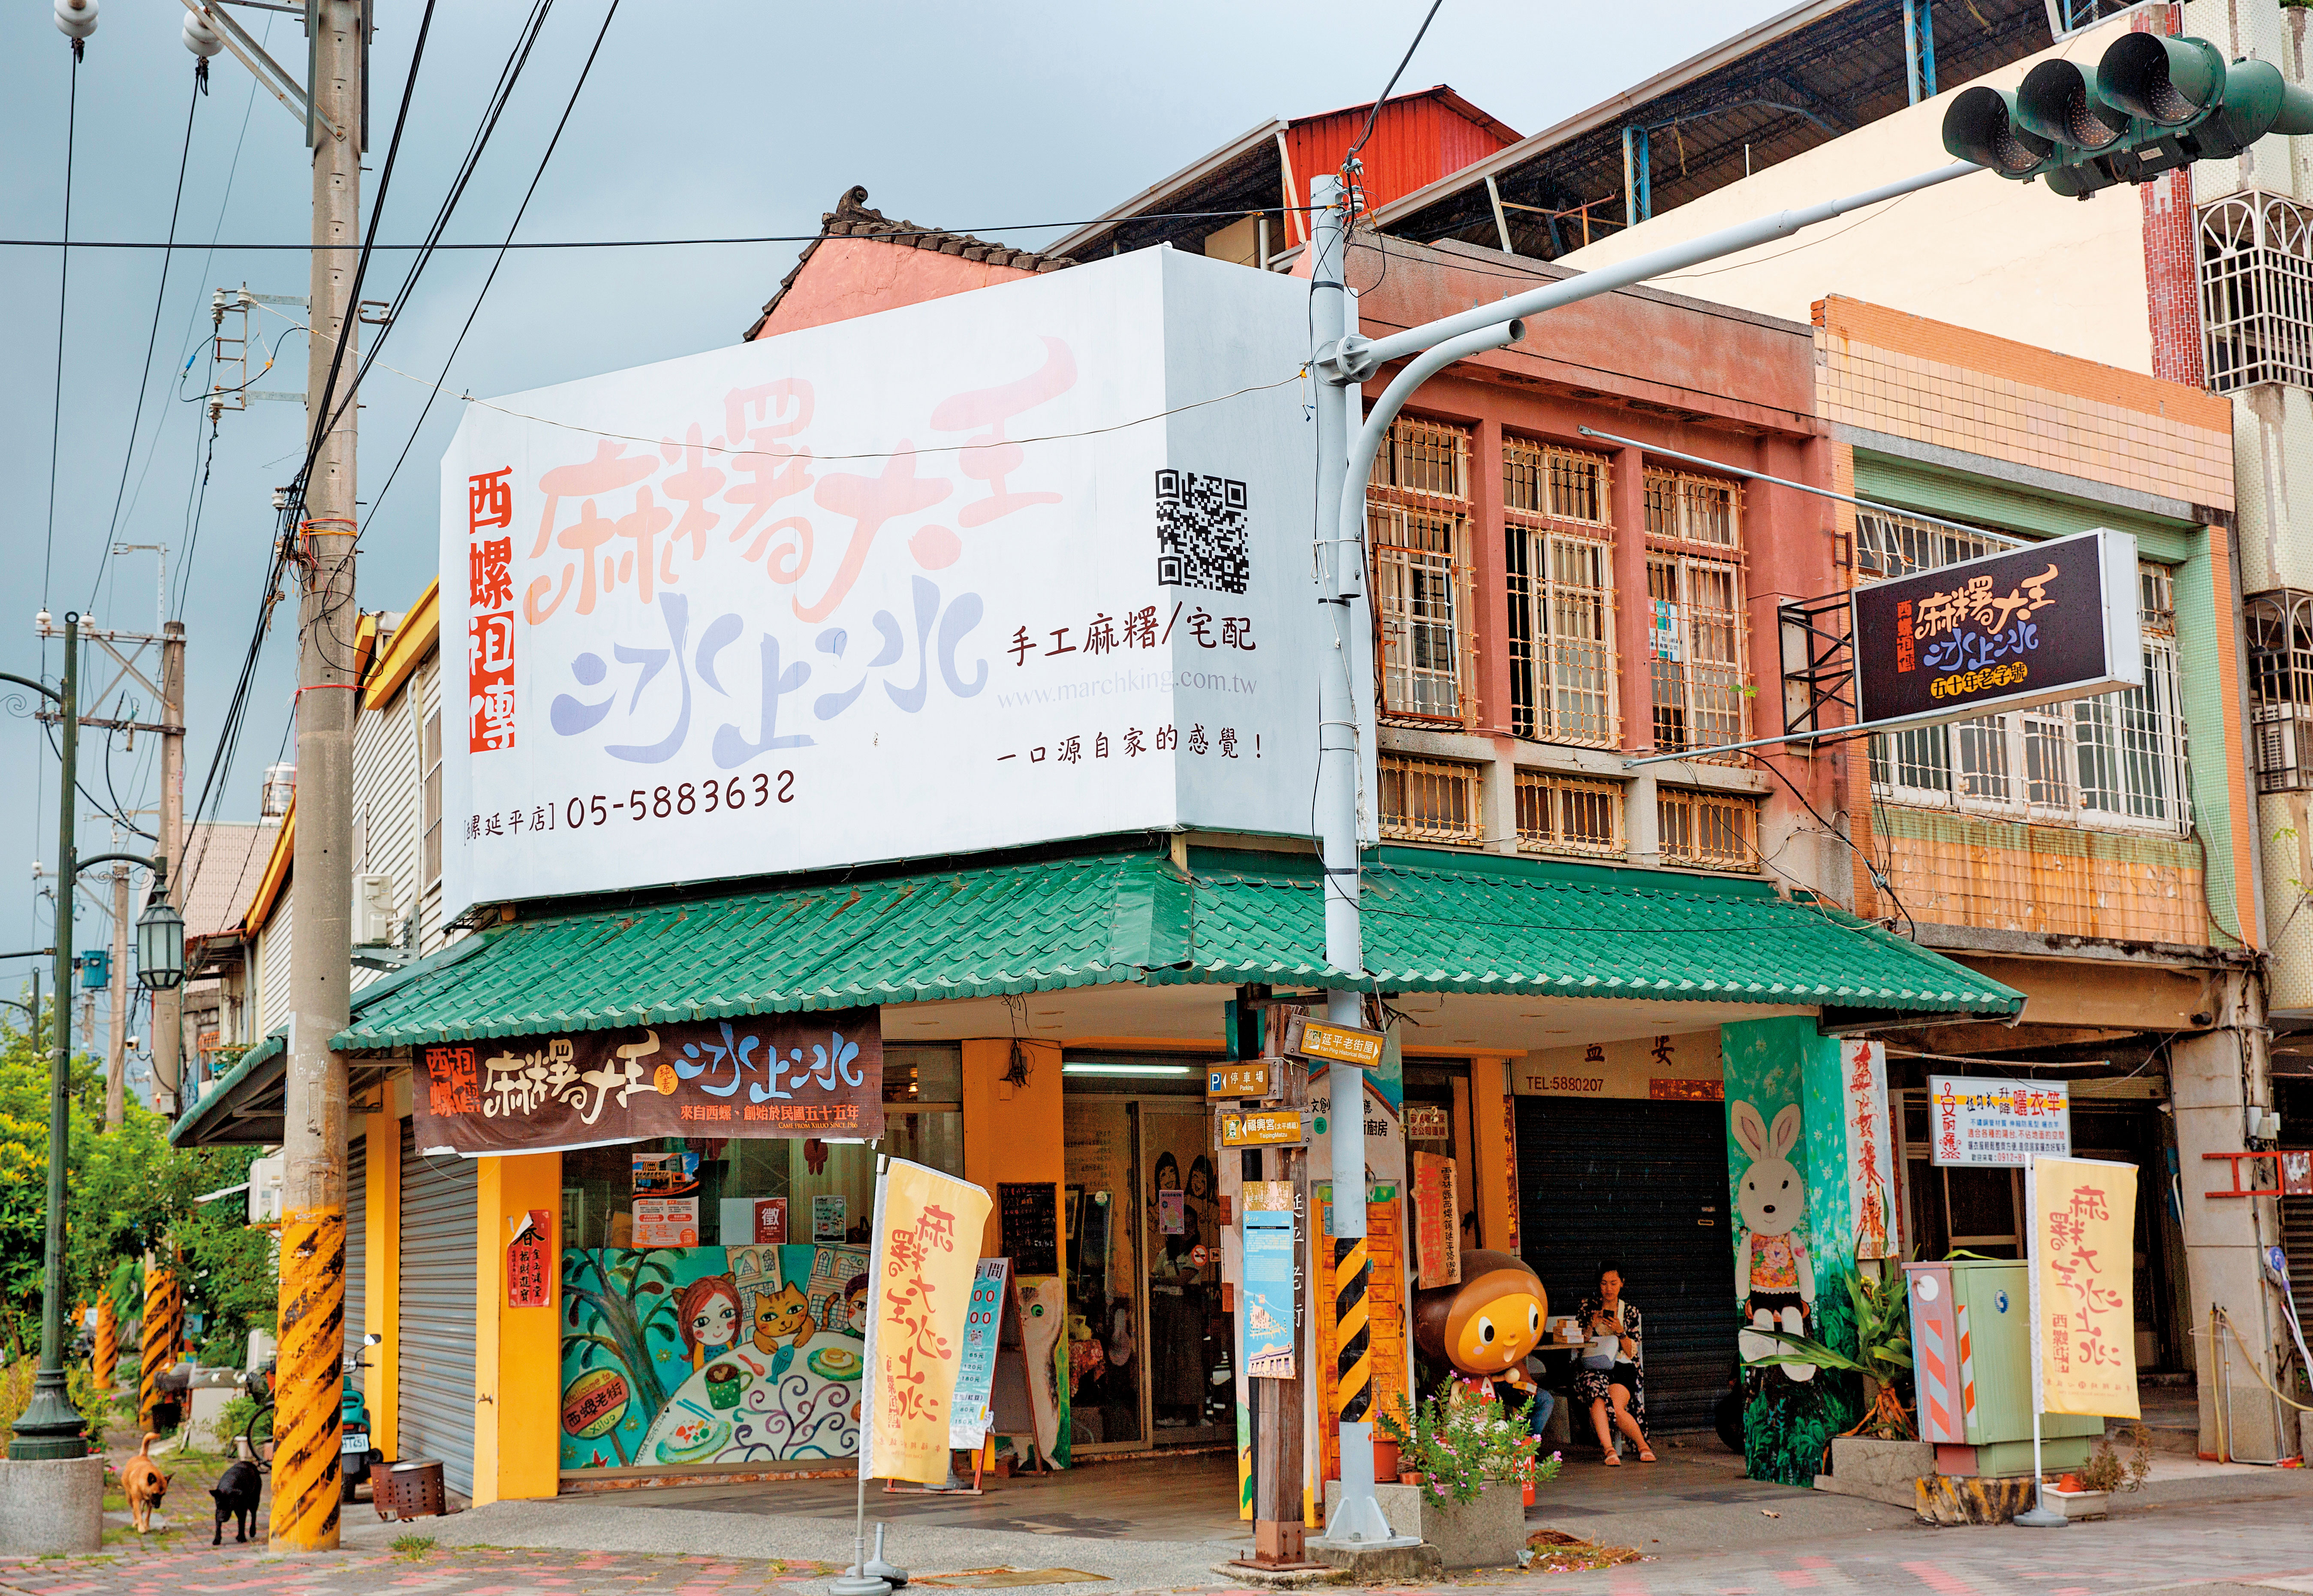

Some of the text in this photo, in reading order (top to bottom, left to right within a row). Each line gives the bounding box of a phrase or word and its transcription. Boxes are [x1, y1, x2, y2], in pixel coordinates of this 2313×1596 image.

[522, 335, 1078, 626] 麻糬大王
[469, 465, 515, 754] 西螺祖傳
[1914, 563, 2059, 640] 麻糬大王
[1897, 599, 1915, 673] 西螺祖傳
[1924, 620, 2039, 671] 冰上冰
[550, 575, 988, 769] 冰上冰
[997, 667, 1257, 709] www.marchking.com.tw
[1931, 661, 2028, 699] 五十年老字號
[566, 770, 795, 830] 05-5883632
[675, 1021, 864, 1104] 冰上冰
[1321, 1033, 1373, 1054] 延平老街屋
[1339, 1049, 1358, 1057] Historical
[483, 1029, 660, 1125] 麻糬大王
[659, 1066, 673, 1093] 純素
[1212, 1074, 1220, 1090] P
[1230, 1070, 1264, 1084] 停車場
[1526, 1076, 1604, 1092] TEL:5880207
[1999, 1087, 2011, 1115] 升降
[2013, 1090, 2060, 1117] 曬衣竿
[762, 1207, 780, 1226] 徵
[519, 1250, 530, 1301] 招財進寶
[531, 1249, 542, 1297] 金玉滿堂
[602, 1372, 611, 1381] to
[566, 1382, 622, 1427] 西螺老街
